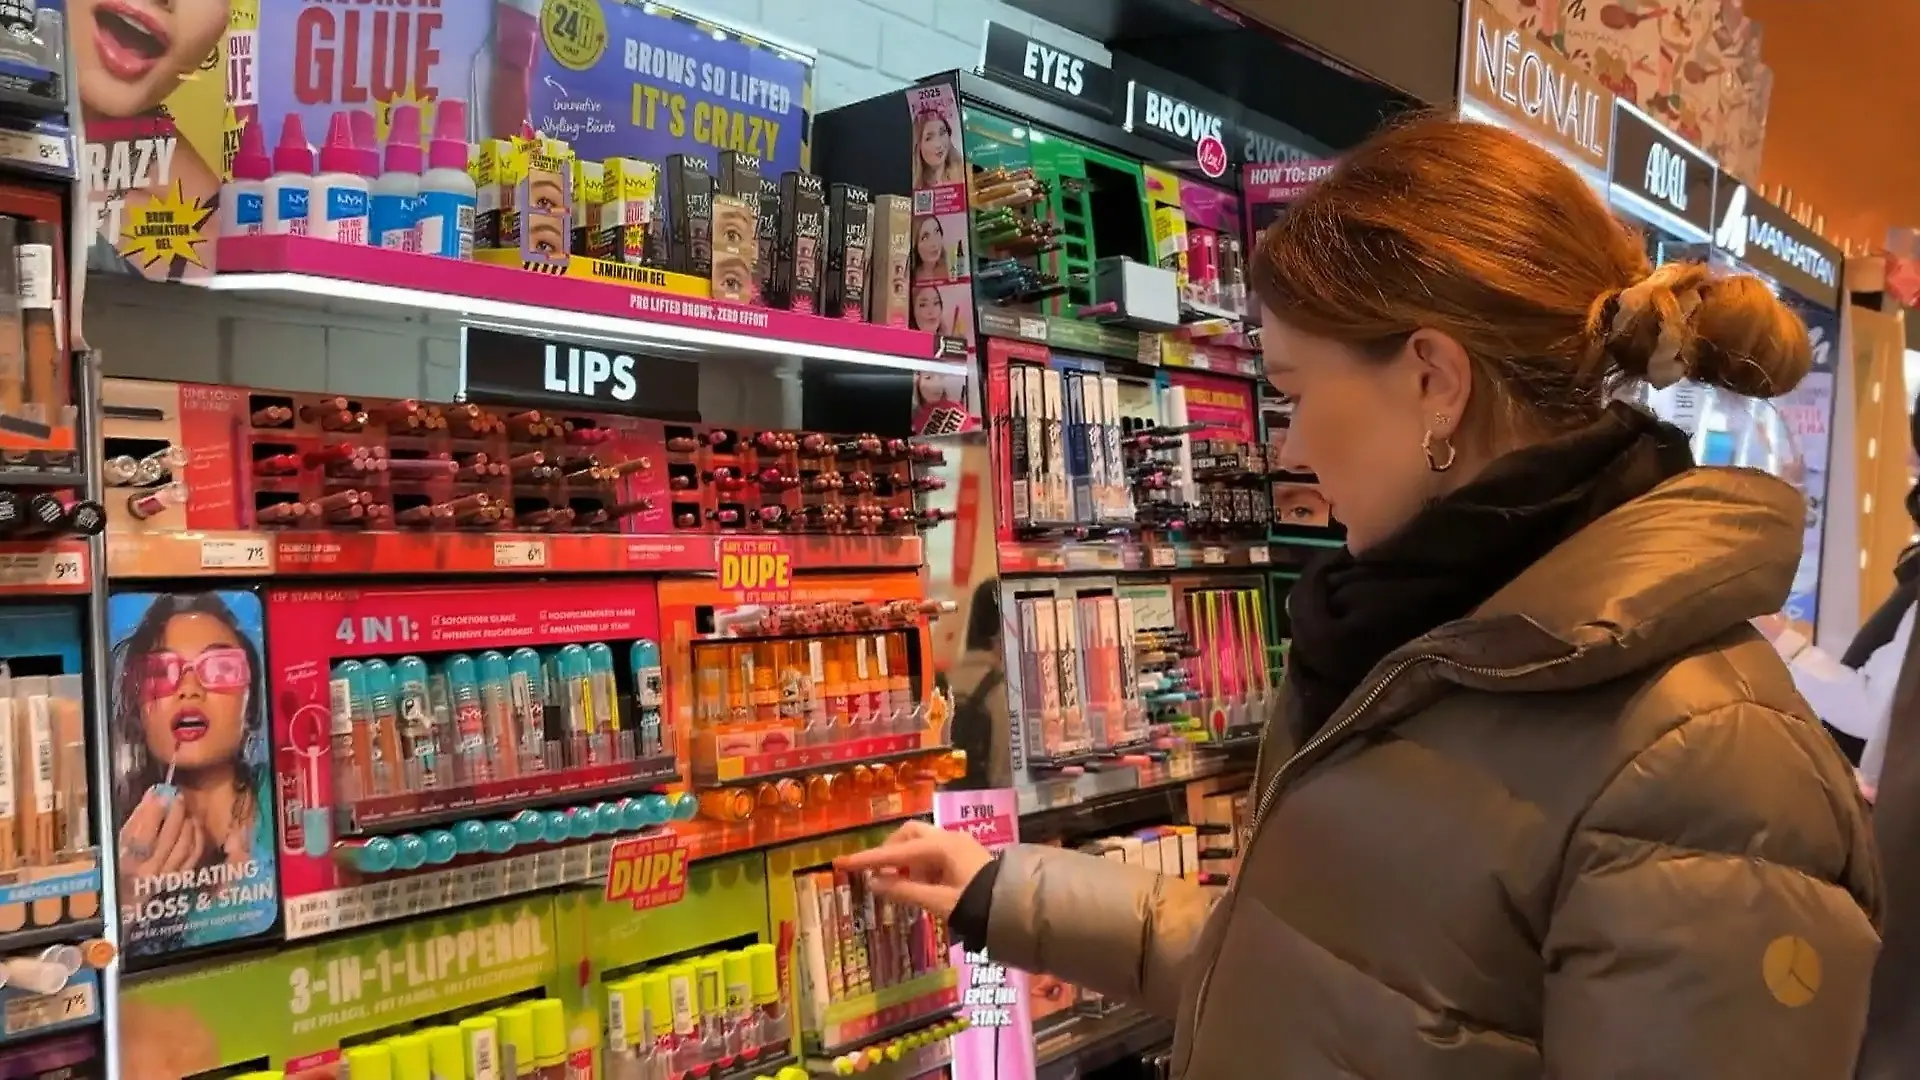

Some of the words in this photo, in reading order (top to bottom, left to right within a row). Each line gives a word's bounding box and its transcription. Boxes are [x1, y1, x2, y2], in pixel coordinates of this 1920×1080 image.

[295, 7, 443, 105] GLUE
[1024, 41, 1084, 96] EYES
[624, 37, 697, 88] BROWS
[701, 62, 726, 97] SO
[730, 71, 791, 115] LIFTED
[1475, 18, 1604, 157] NÉONAIL
[918, 87, 941, 99] 2025
[632, 83, 687, 138] IT'S
[693, 101, 780, 161] CRAZY
[1146, 92, 1222, 142] BROWS
[684, 156, 709, 169] NYX
[736, 153, 760, 168] NYX
[1251, 168, 1281, 185] HOW
[1283, 166, 1305, 183] TO:
[625, 178, 647, 188] NYX
[799, 175, 822, 190] NYX
[847, 188, 868, 202] NYX
[337, 193, 364, 205] NYX
[1749, 214, 1836, 288] MANHATTAN
[592, 261, 648, 285] LAMINATION
[650, 272, 666, 287] GEL
[630, 294, 649, 311] PRO
[650, 297, 680, 315] LIFTED
[717, 308, 738, 324] ZERO
[739, 310, 769, 328] EFFORT
[544, 345, 637, 401] LIPS
[722, 553, 790, 590] DUPE
[335, 617, 356, 645] 4
[361, 616, 394, 645] IN
[397, 614, 419, 643] 1:
[961, 804, 970, 819] IF
[972, 803, 994, 818] YOU
[133, 858, 260, 897] HYDRATING
[610, 848, 688, 898] DUPE
[195, 891, 212, 913] &
[219, 880, 274, 909] STAIN
[964, 987, 994, 1006] EPIC
[971, 1008, 1013, 1027] STAYS.
